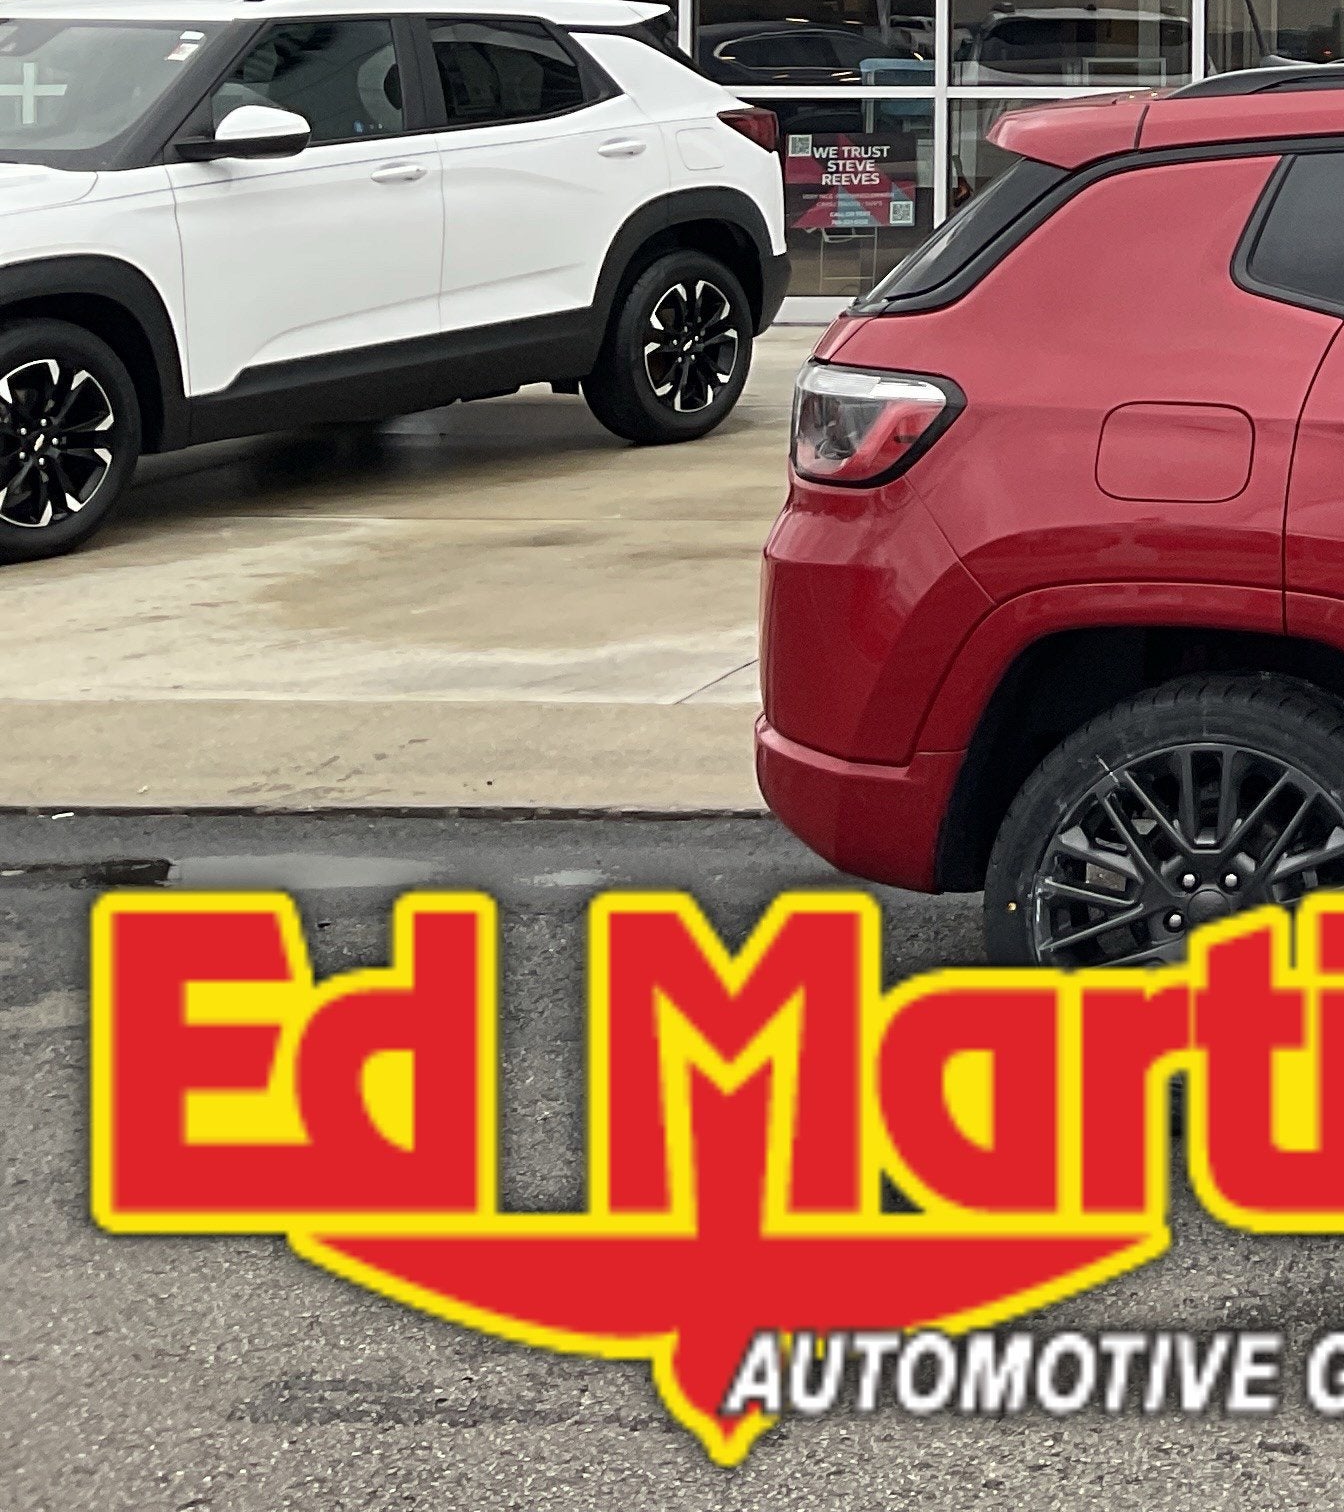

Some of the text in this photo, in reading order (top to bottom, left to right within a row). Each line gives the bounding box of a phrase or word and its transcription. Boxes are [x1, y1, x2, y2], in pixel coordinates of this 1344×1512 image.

[813, 146, 890, 158] WE TRUST
[827, 159, 876, 172] STEVE
[821, 172, 880, 186] REEVES
